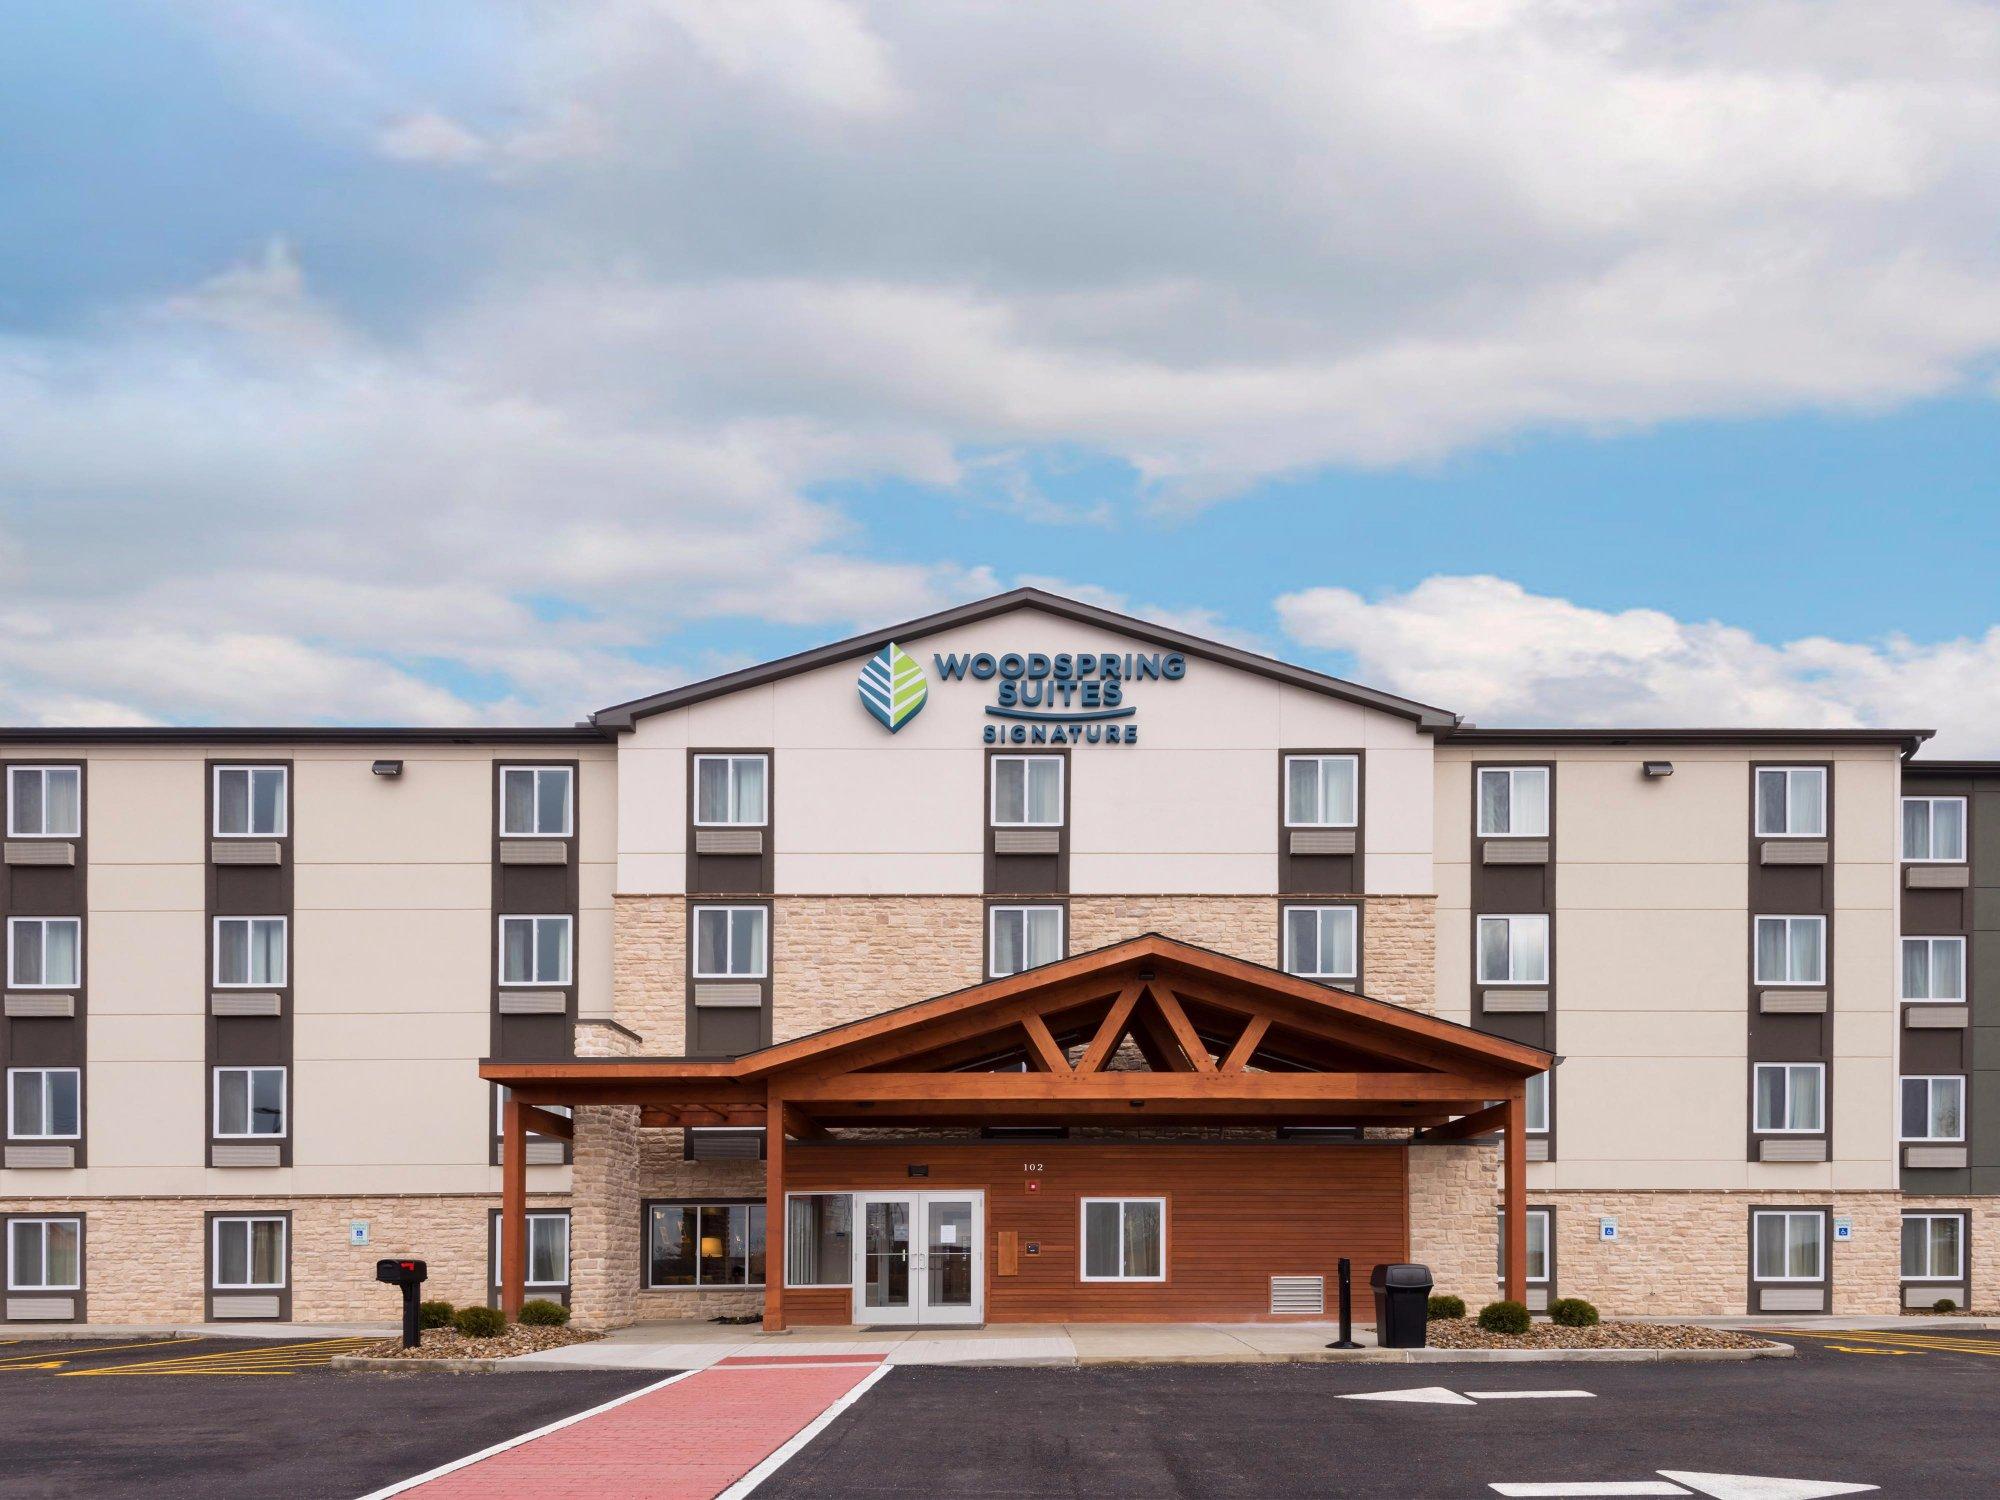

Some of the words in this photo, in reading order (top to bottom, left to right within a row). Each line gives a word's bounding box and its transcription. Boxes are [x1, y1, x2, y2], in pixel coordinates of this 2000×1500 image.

[933, 653, 1186, 681] WOODSPRING
[998, 680, 1123, 707] SUITES
[983, 725, 1138, 744] SIGNATURE
[1024, 1163, 1043, 1171] 102
